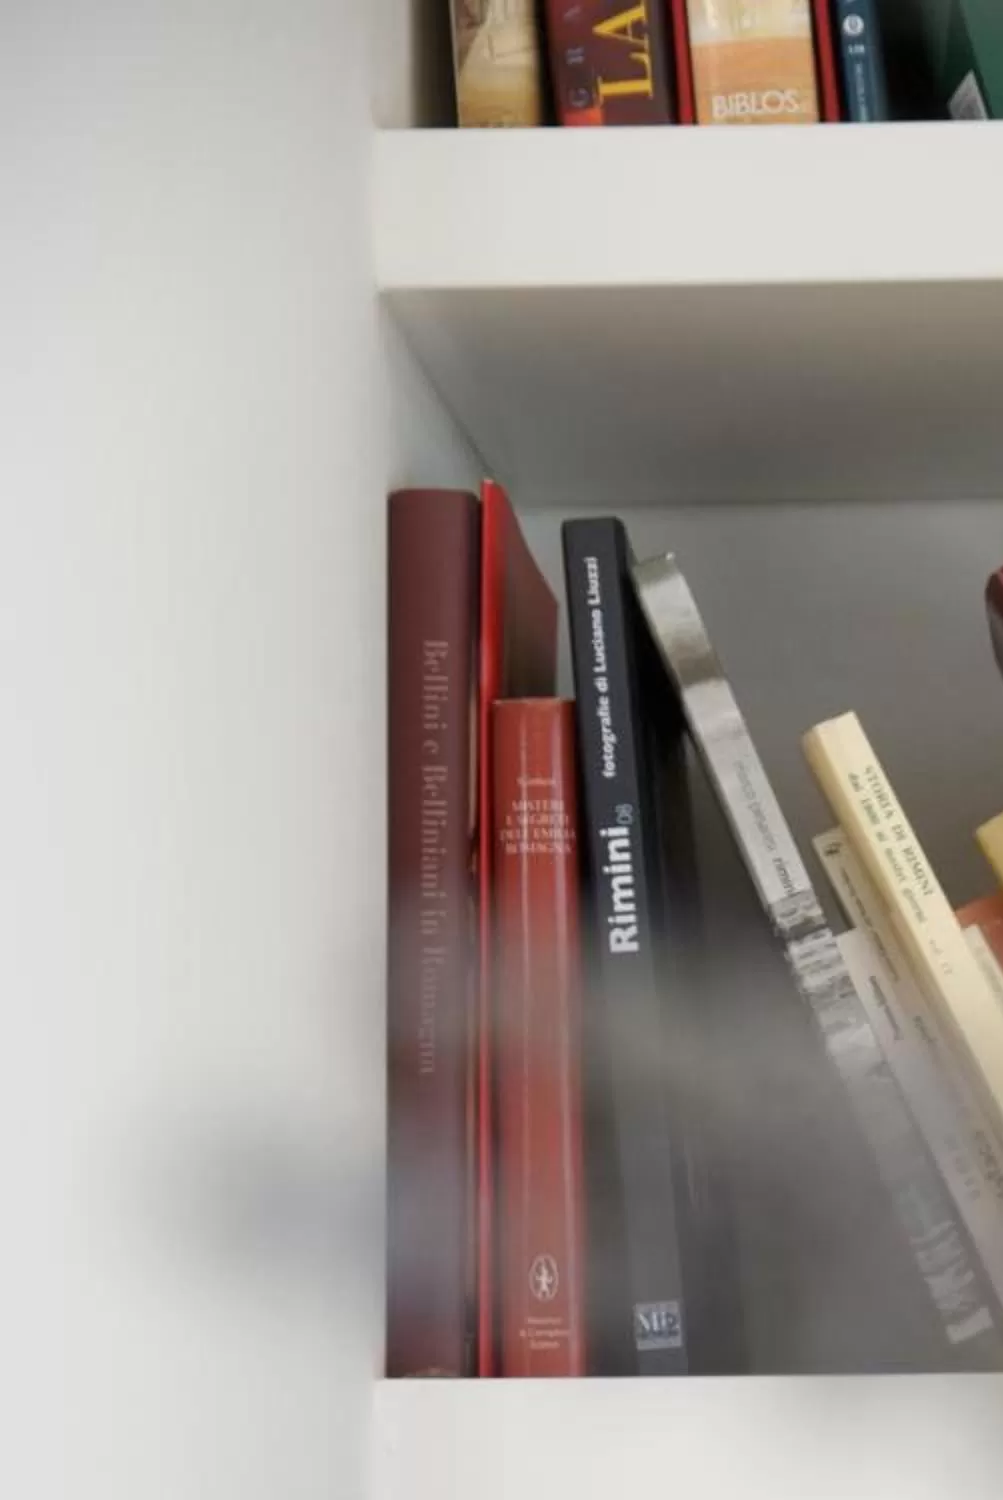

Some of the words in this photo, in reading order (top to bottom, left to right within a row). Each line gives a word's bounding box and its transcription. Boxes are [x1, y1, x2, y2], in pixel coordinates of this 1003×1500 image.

[710, 88, 800, 118] BIBLOS
[592, 608, 607, 671] Luciano
[420, 640, 449, 729] Bellini
[596, 676, 610, 691] di
[599, 695, 617, 777] fotografie
[420, 765, 448, 897] Belliniani
[860, 764, 897, 819] STORIA
[890, 821, 908, 841] DI
[900, 844, 937, 896] RIMINI
[420, 909, 446, 934] in
[600, 826, 639, 953] Rimini
